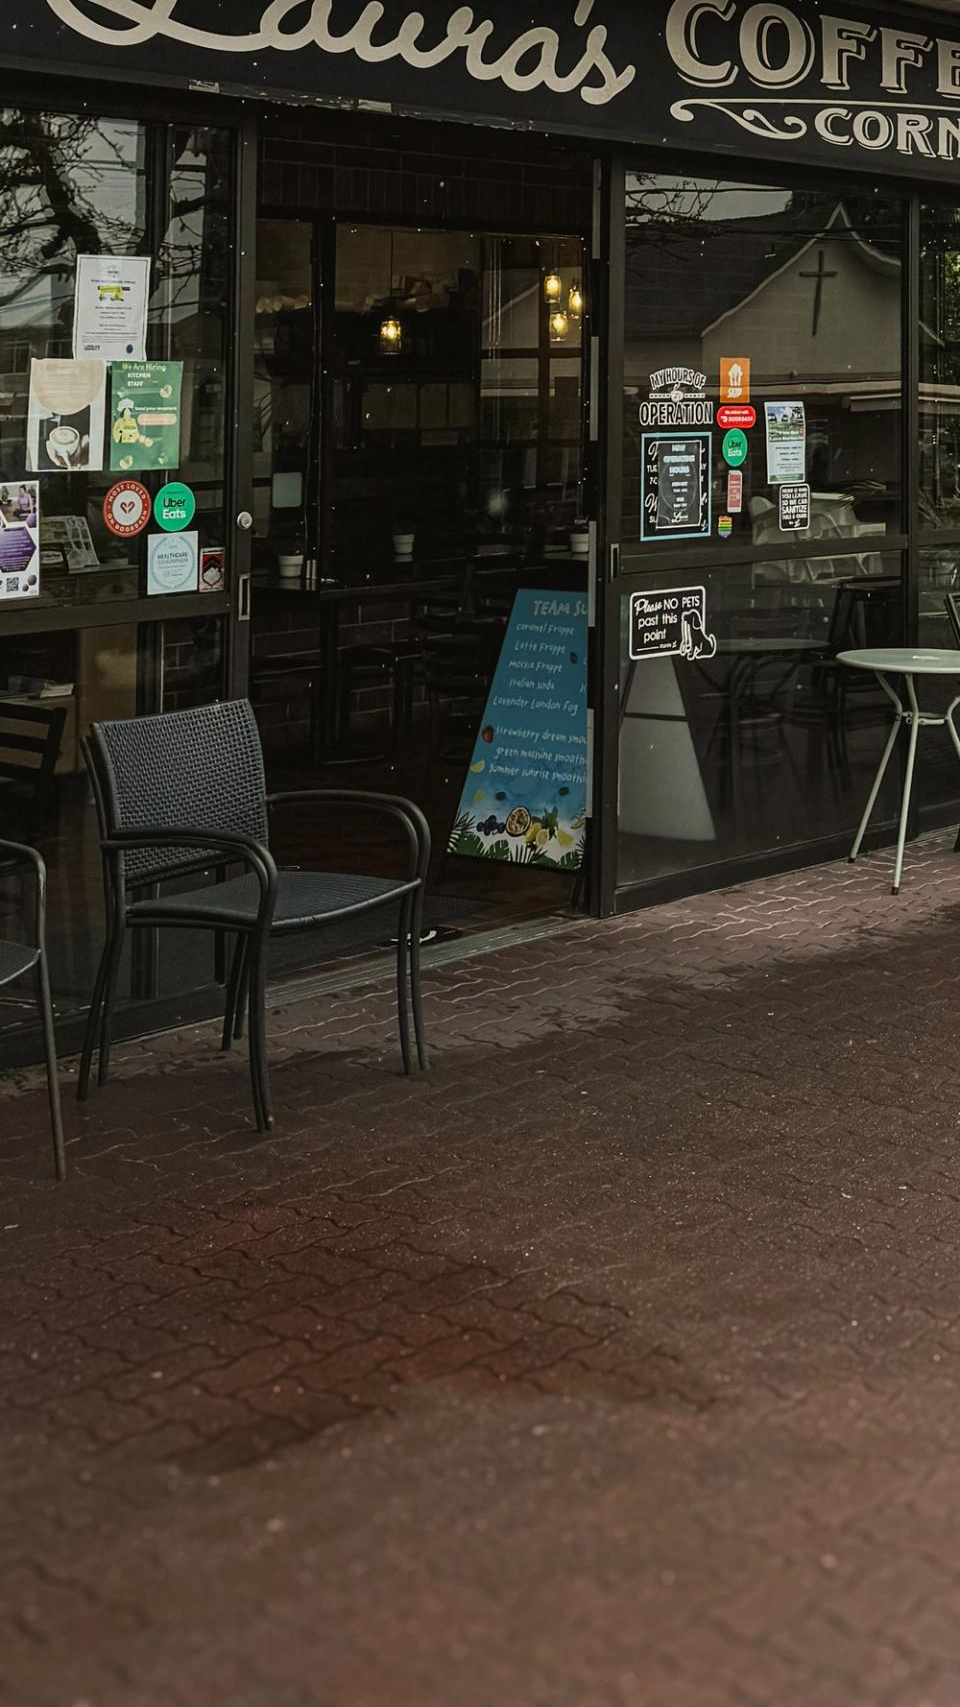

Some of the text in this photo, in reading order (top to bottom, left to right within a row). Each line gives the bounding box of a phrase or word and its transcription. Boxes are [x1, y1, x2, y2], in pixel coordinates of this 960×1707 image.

[122, 362, 166, 372] We Are Hiring
[664, 367, 695, 386] HOURS
[693, 372, 707, 390] OF
[639, 401, 714, 426] OPERATION
[728, 448, 743, 457] Eats
[108, 483, 146, 502] MOST LOVED
[163, 498, 186, 508] Uber
[782, 505, 808, 514] SANITIZE
[162, 509, 187, 519] Eats
[533, 599, 570, 616] TEAM
[634, 595, 699, 616] Please NO PETS
[638, 613, 677, 630] past this
[644, 628, 667, 644] point
[514, 638, 538, 652] Latte
[509, 677, 535, 689] Italian
[493, 694, 528, 707] Lavender
[530, 698, 560, 710] London
[541, 728, 567, 742] dream
[494, 746, 519, 759] green
[520, 748, 553, 761] machine
